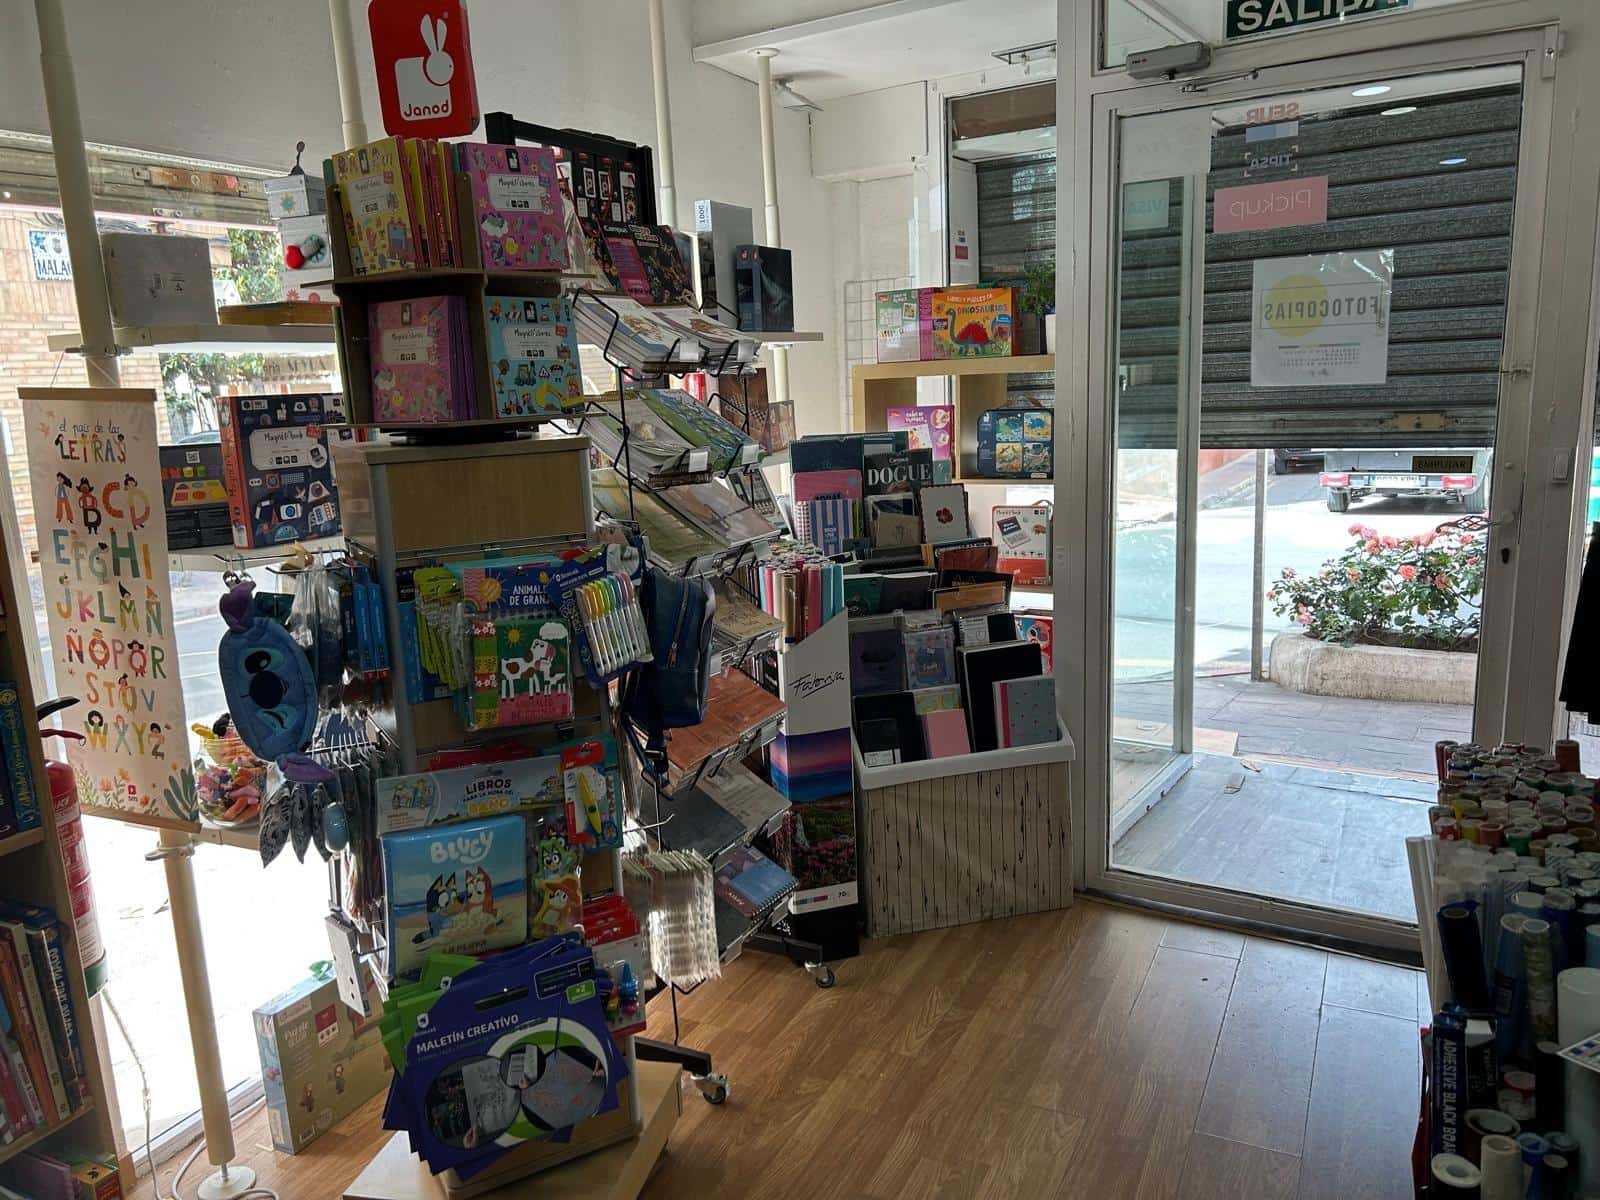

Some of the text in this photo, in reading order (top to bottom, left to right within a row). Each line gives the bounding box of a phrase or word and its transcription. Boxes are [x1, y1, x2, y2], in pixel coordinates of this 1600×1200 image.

[1237, 0, 1397, 32] SALI
[404, 99, 449, 118] Janod
[59, 417, 67, 433] el
[94, 419, 104, 433] de
[109, 419, 120, 434] las
[57, 434, 126, 464] LETRAS
[868, 463, 931, 486] DOGUE
[510, 596, 520, 606] DE
[465, 779, 512, 795] LIBROS
[416, 1028, 465, 1055] MALETÍN
[1442, 1039, 1457, 1092] ADHESIVE
[1442, 1093, 1457, 1125] BLACK
